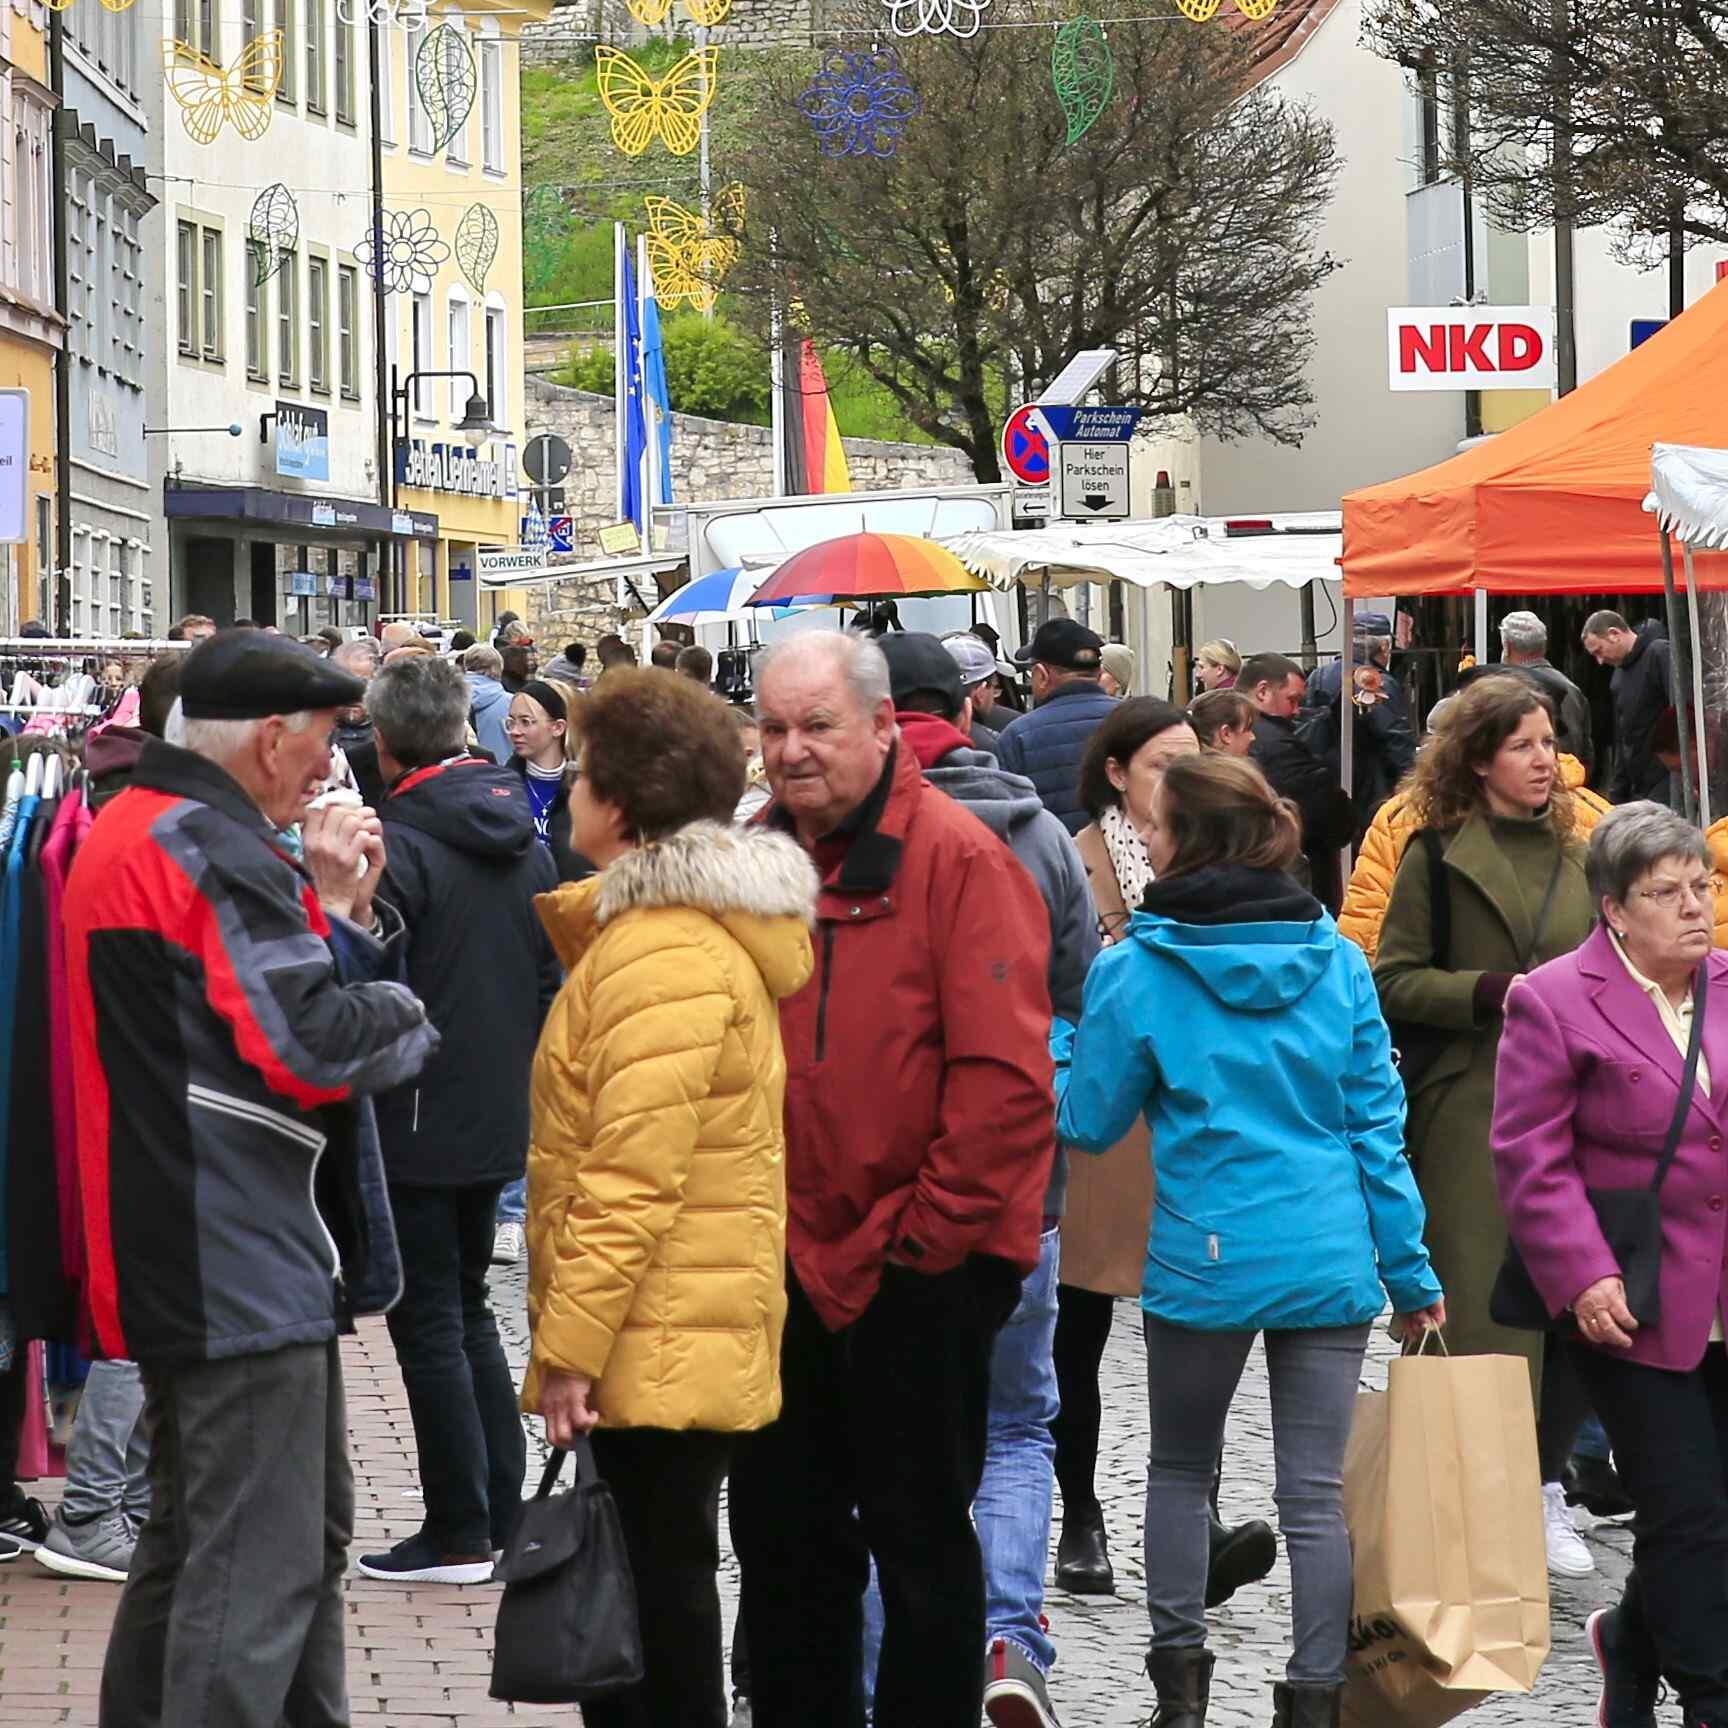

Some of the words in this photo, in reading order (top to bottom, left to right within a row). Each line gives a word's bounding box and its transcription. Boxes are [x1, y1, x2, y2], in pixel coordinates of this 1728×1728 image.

[1399, 323, 1544, 373] NKD
[1073, 410, 1132, 425] Parkschein
[1075, 425, 1122, 438] Automat
[1083, 448, 1106, 461] Hier
[1066, 463, 1125, 476] Parkschein
[1081, 479, 1110, 491] lösen
[480, 555, 542, 569] VORWERK
